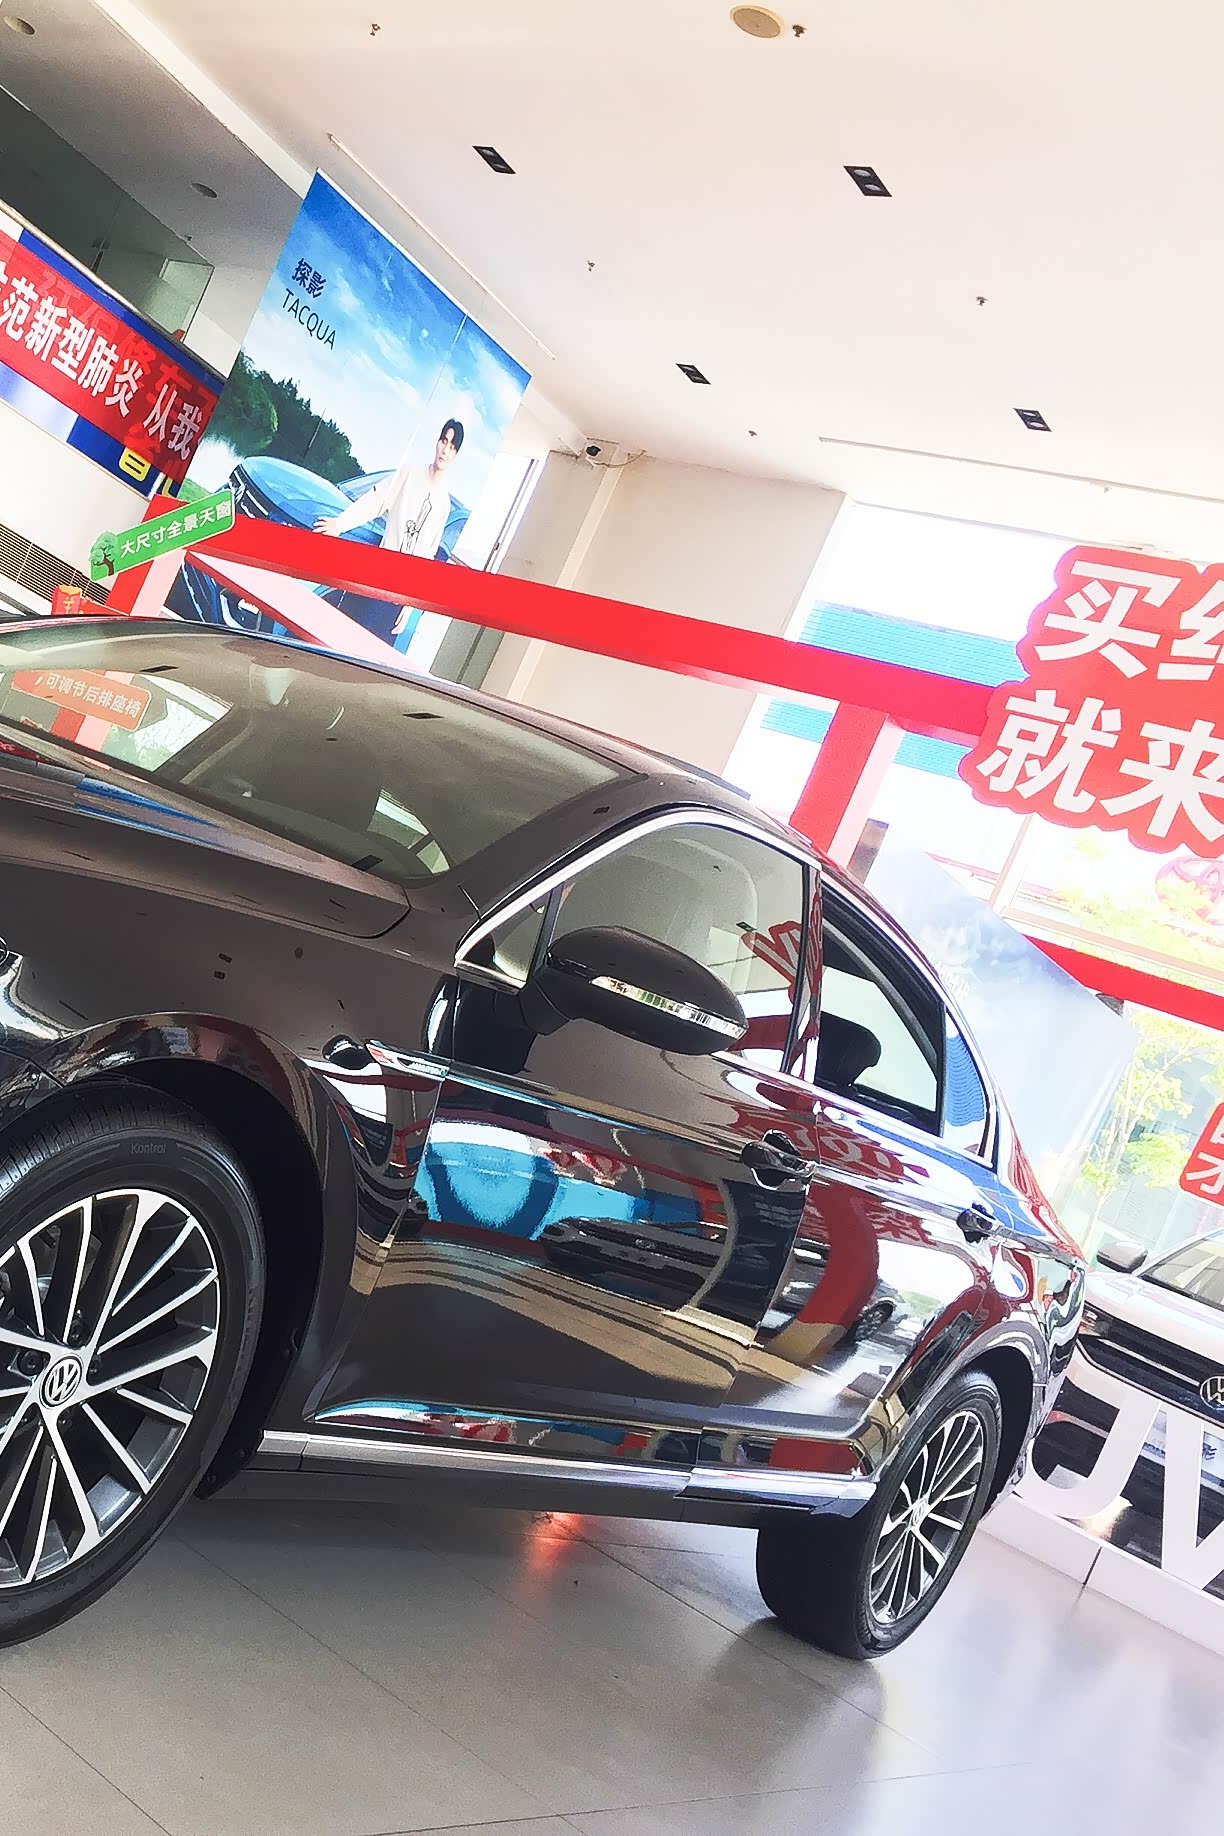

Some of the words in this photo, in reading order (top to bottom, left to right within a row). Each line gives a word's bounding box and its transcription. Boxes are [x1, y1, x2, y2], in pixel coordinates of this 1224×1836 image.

[292, 258, 326, 298] 探影
[282, 287, 336, 350] TACQUA
[142, 383, 203, 461] 从我
[119, 500, 232, 559] 大尺寸全景天窗
[45, 672, 142, 718] 可调节后排座椅
[976, 689, 1224, 843] 就来
[130, 1142, 167, 1154] Kontrol
